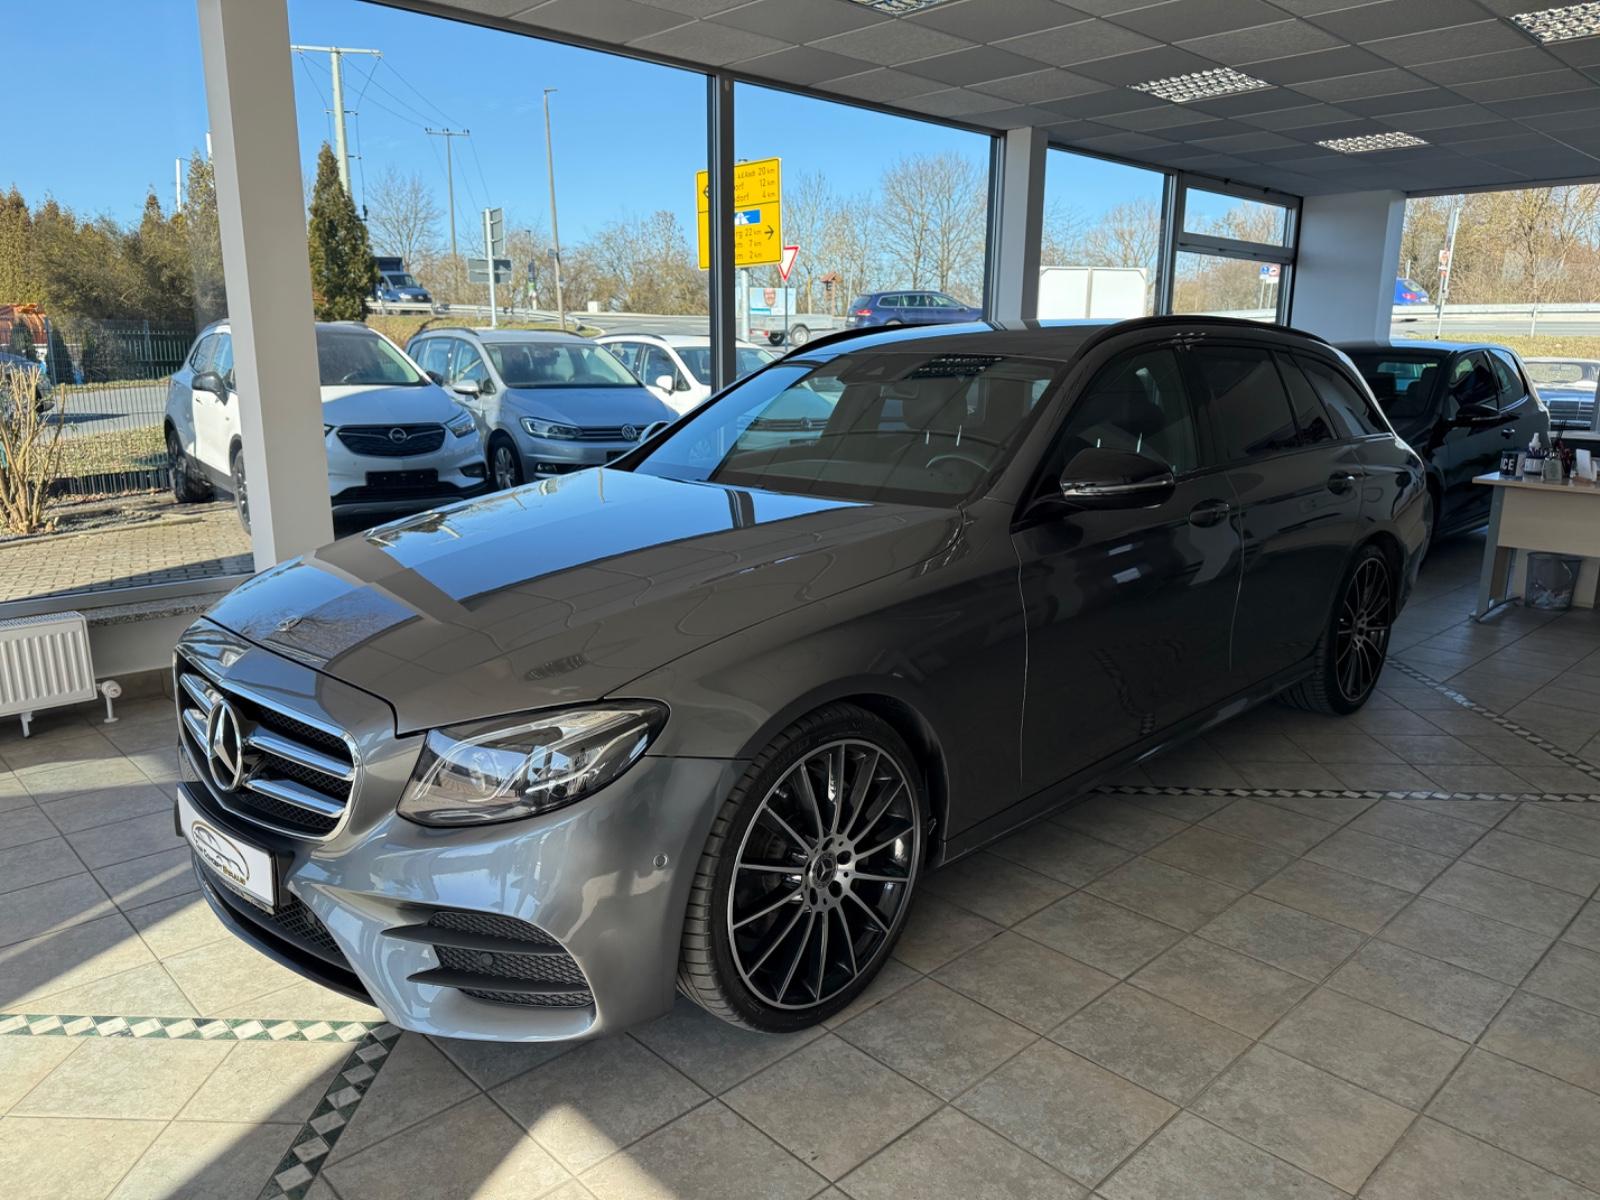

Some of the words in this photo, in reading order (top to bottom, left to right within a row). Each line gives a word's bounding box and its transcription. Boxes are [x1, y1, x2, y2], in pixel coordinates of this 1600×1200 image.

[758, 166, 766, 176] 20
[760, 178, 766, 188] 12
[745, 228, 753, 237] 22
